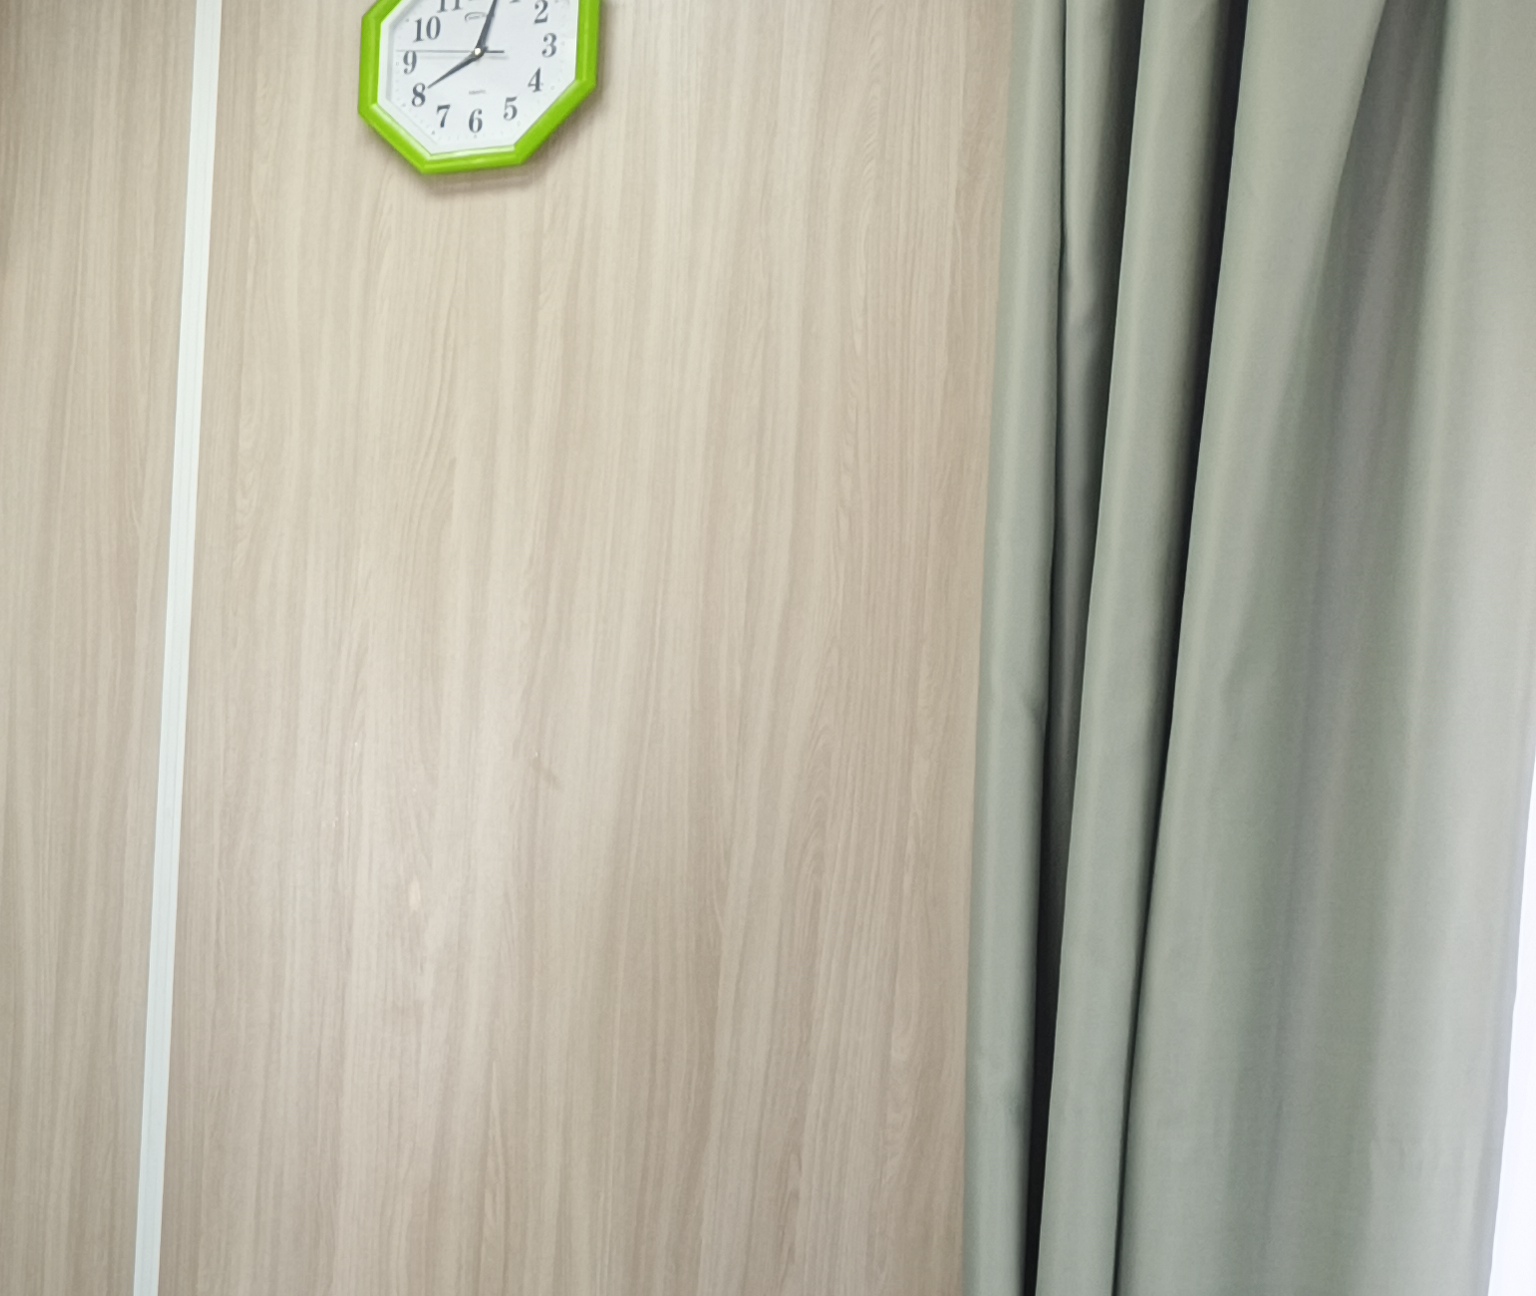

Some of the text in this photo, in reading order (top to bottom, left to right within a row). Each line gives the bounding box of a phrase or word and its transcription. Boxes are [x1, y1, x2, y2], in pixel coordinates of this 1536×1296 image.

[533, 0, 548, 24] 2
[413, 16, 441, 42] 10
[542, 33, 557, 57] 3
[403, 51, 417, 75] 9
[528, 67, 543, 92] 4
[412, 83, 426, 107] 8
[436, 104, 451, 128] 7
[503, 96, 518, 120] 5
[469, 109, 483, 133] 6
